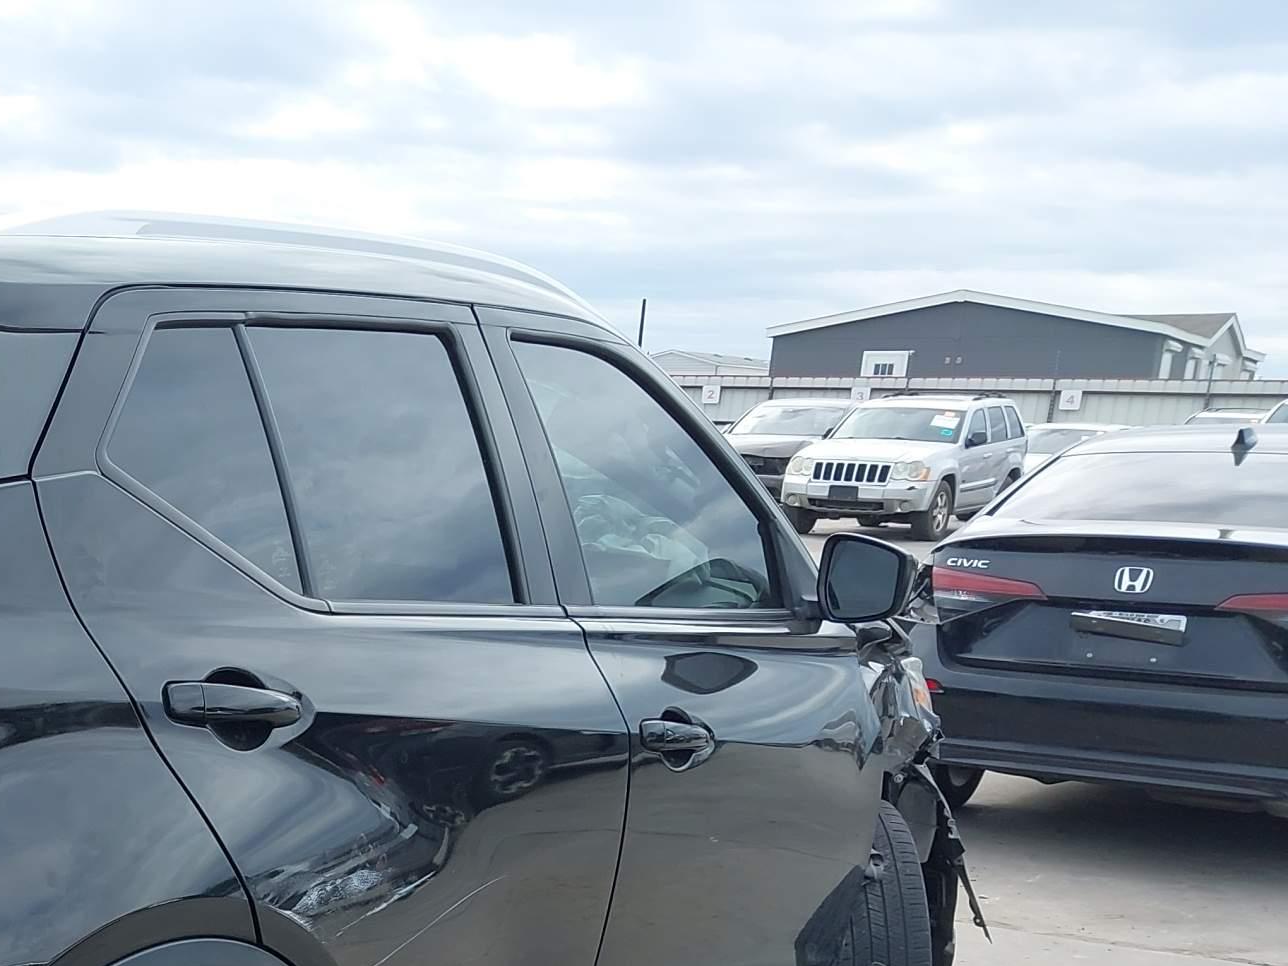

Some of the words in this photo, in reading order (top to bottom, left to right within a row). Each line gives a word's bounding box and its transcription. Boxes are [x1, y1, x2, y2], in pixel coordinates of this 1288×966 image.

[706, 389, 715, 400] 2
[856, 391, 864, 401] 3
[1065, 394, 1075, 405] 4
[946, 557, 991, 569] CIVIC
